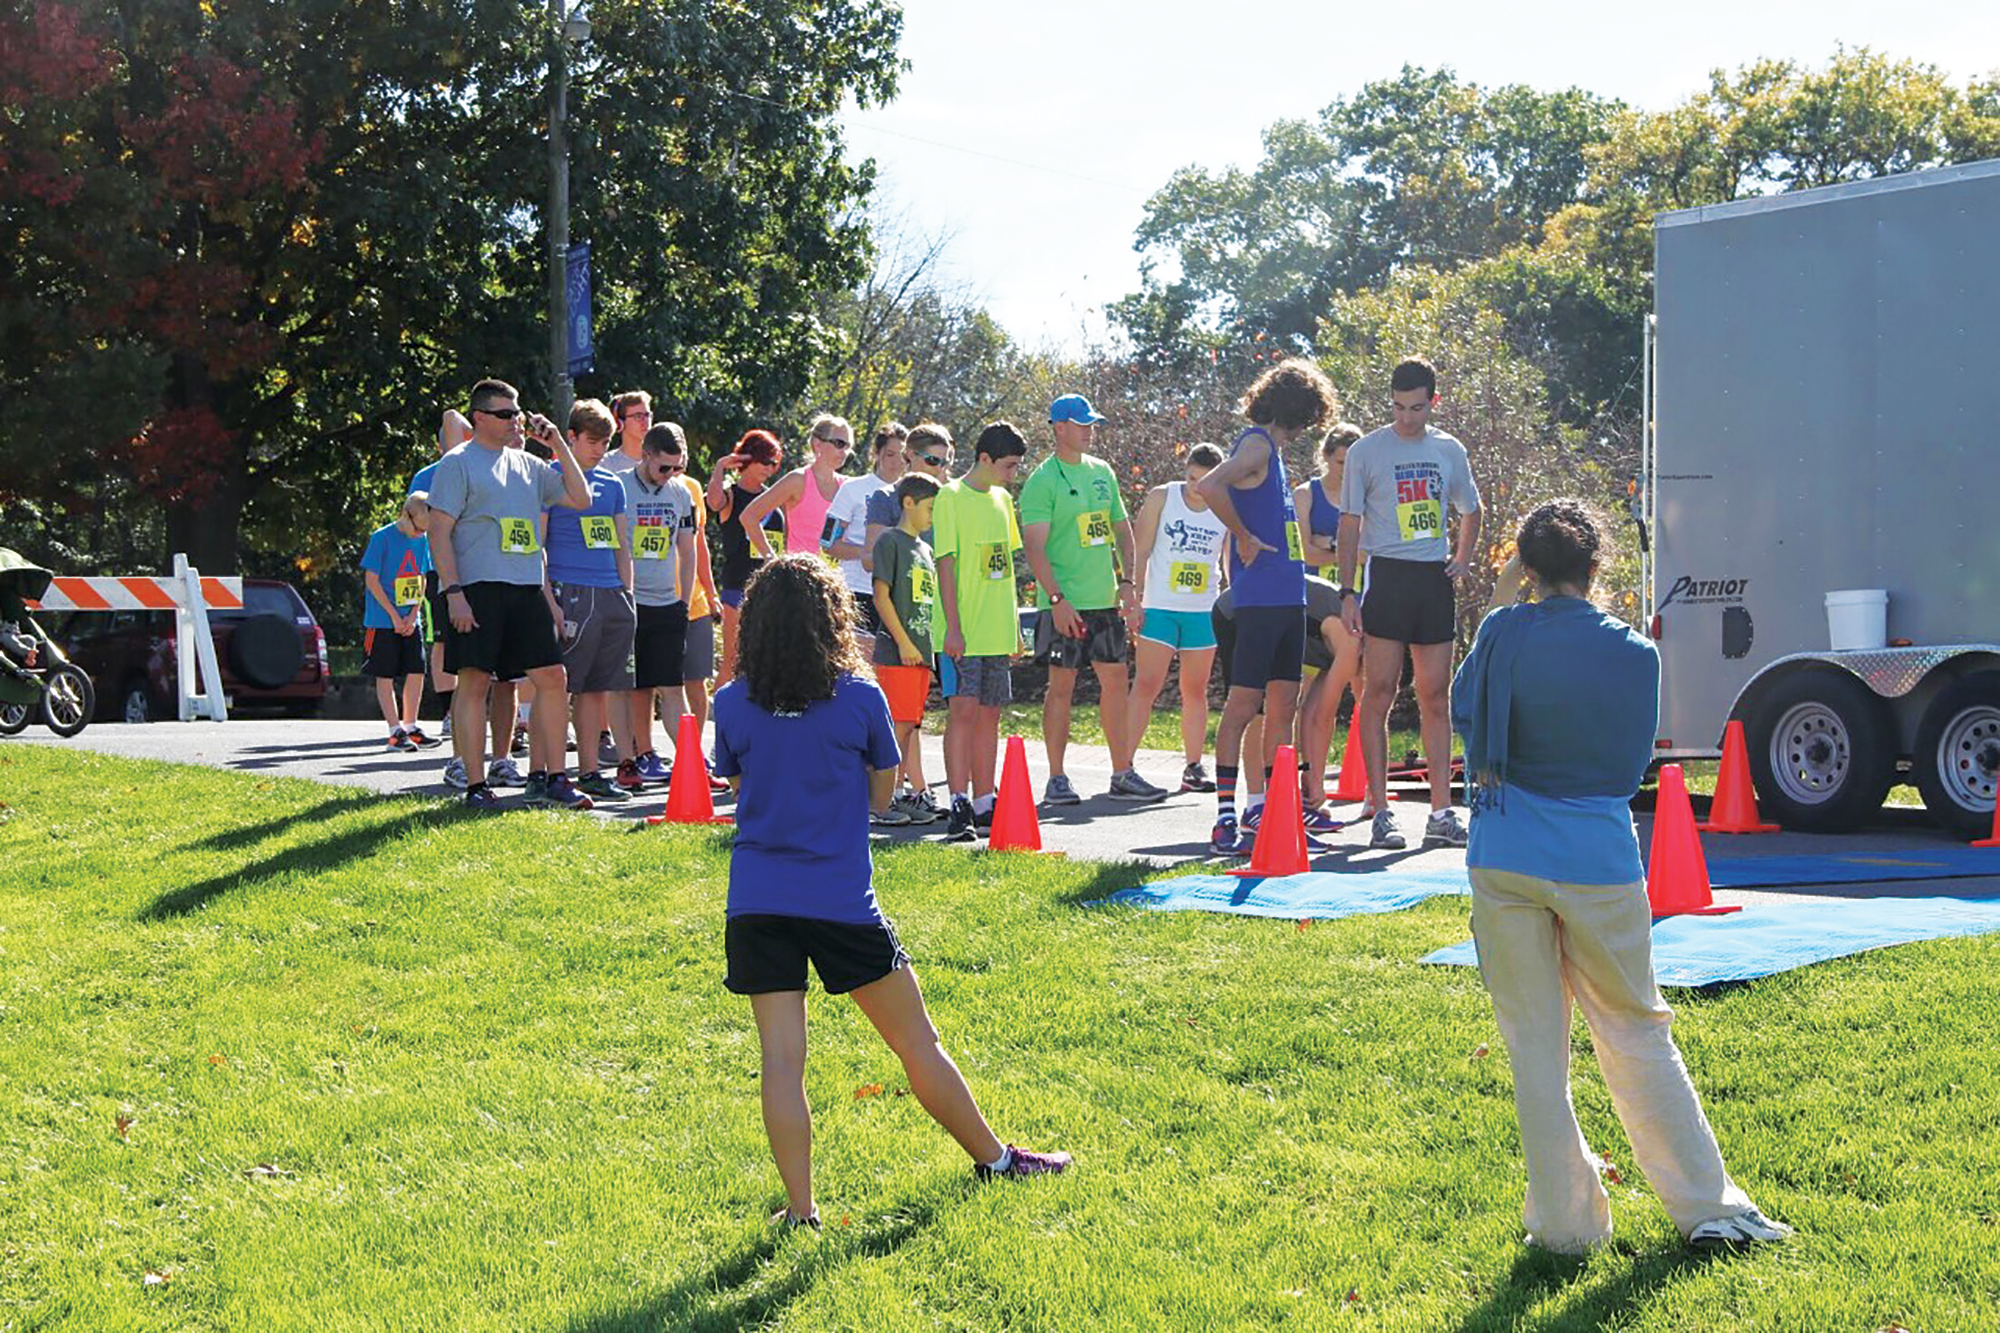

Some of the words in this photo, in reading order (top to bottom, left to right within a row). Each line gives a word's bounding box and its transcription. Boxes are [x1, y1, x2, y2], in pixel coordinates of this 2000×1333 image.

[1397, 479, 1429, 504] 5K
[1087, 521, 1110, 538] 465
[1408, 512, 1437, 530] 466
[509, 528, 531, 546] 459
[590, 526, 612, 541] 460
[641, 536, 666, 551] 457
[1176, 571, 1203, 587] 469
[920, 580, 934, 597] 45
[1657, 575, 1749, 612] PATRIOT
